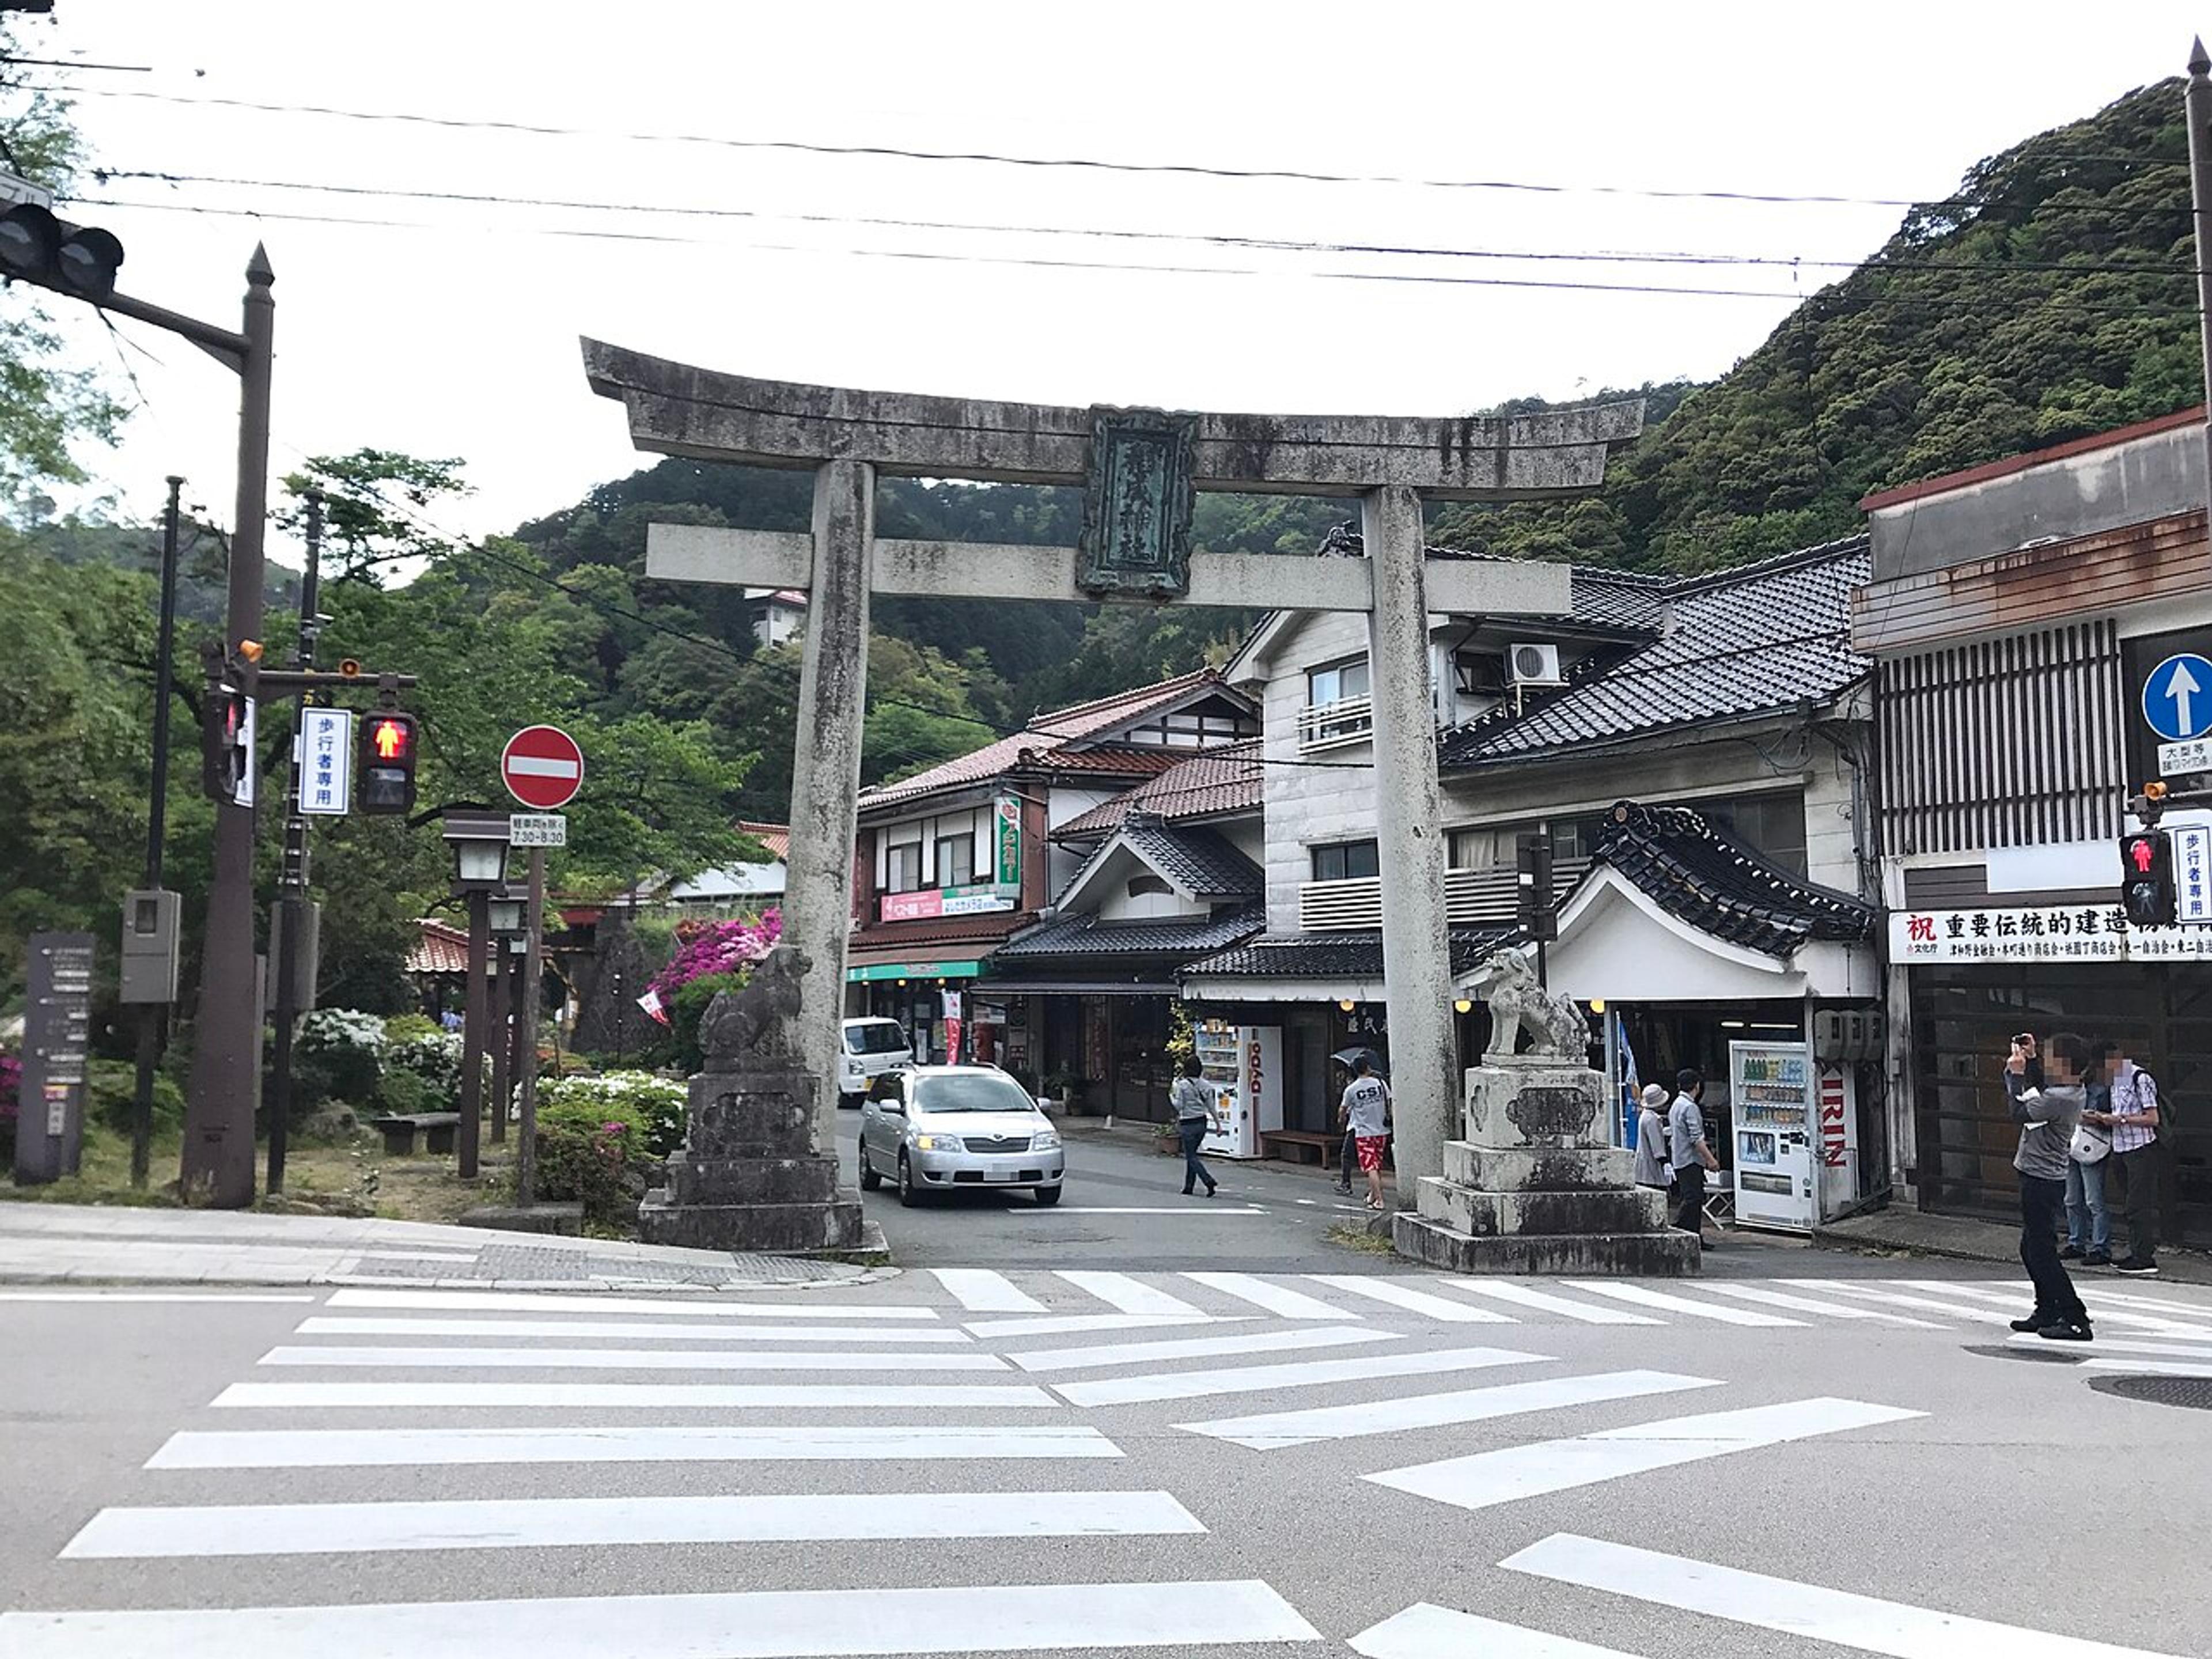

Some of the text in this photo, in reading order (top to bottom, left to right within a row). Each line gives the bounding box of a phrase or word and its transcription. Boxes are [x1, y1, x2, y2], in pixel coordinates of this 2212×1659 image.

[316, 718, 334, 804] 歩行者専用
[2186, 834, 2202, 916] 歩行者専用
[1906, 914, 1938, 941] 祝
[1945, 907, 2212, 938] 重要伝統的建造
[1251, 1042, 1264, 1093] DyDo
